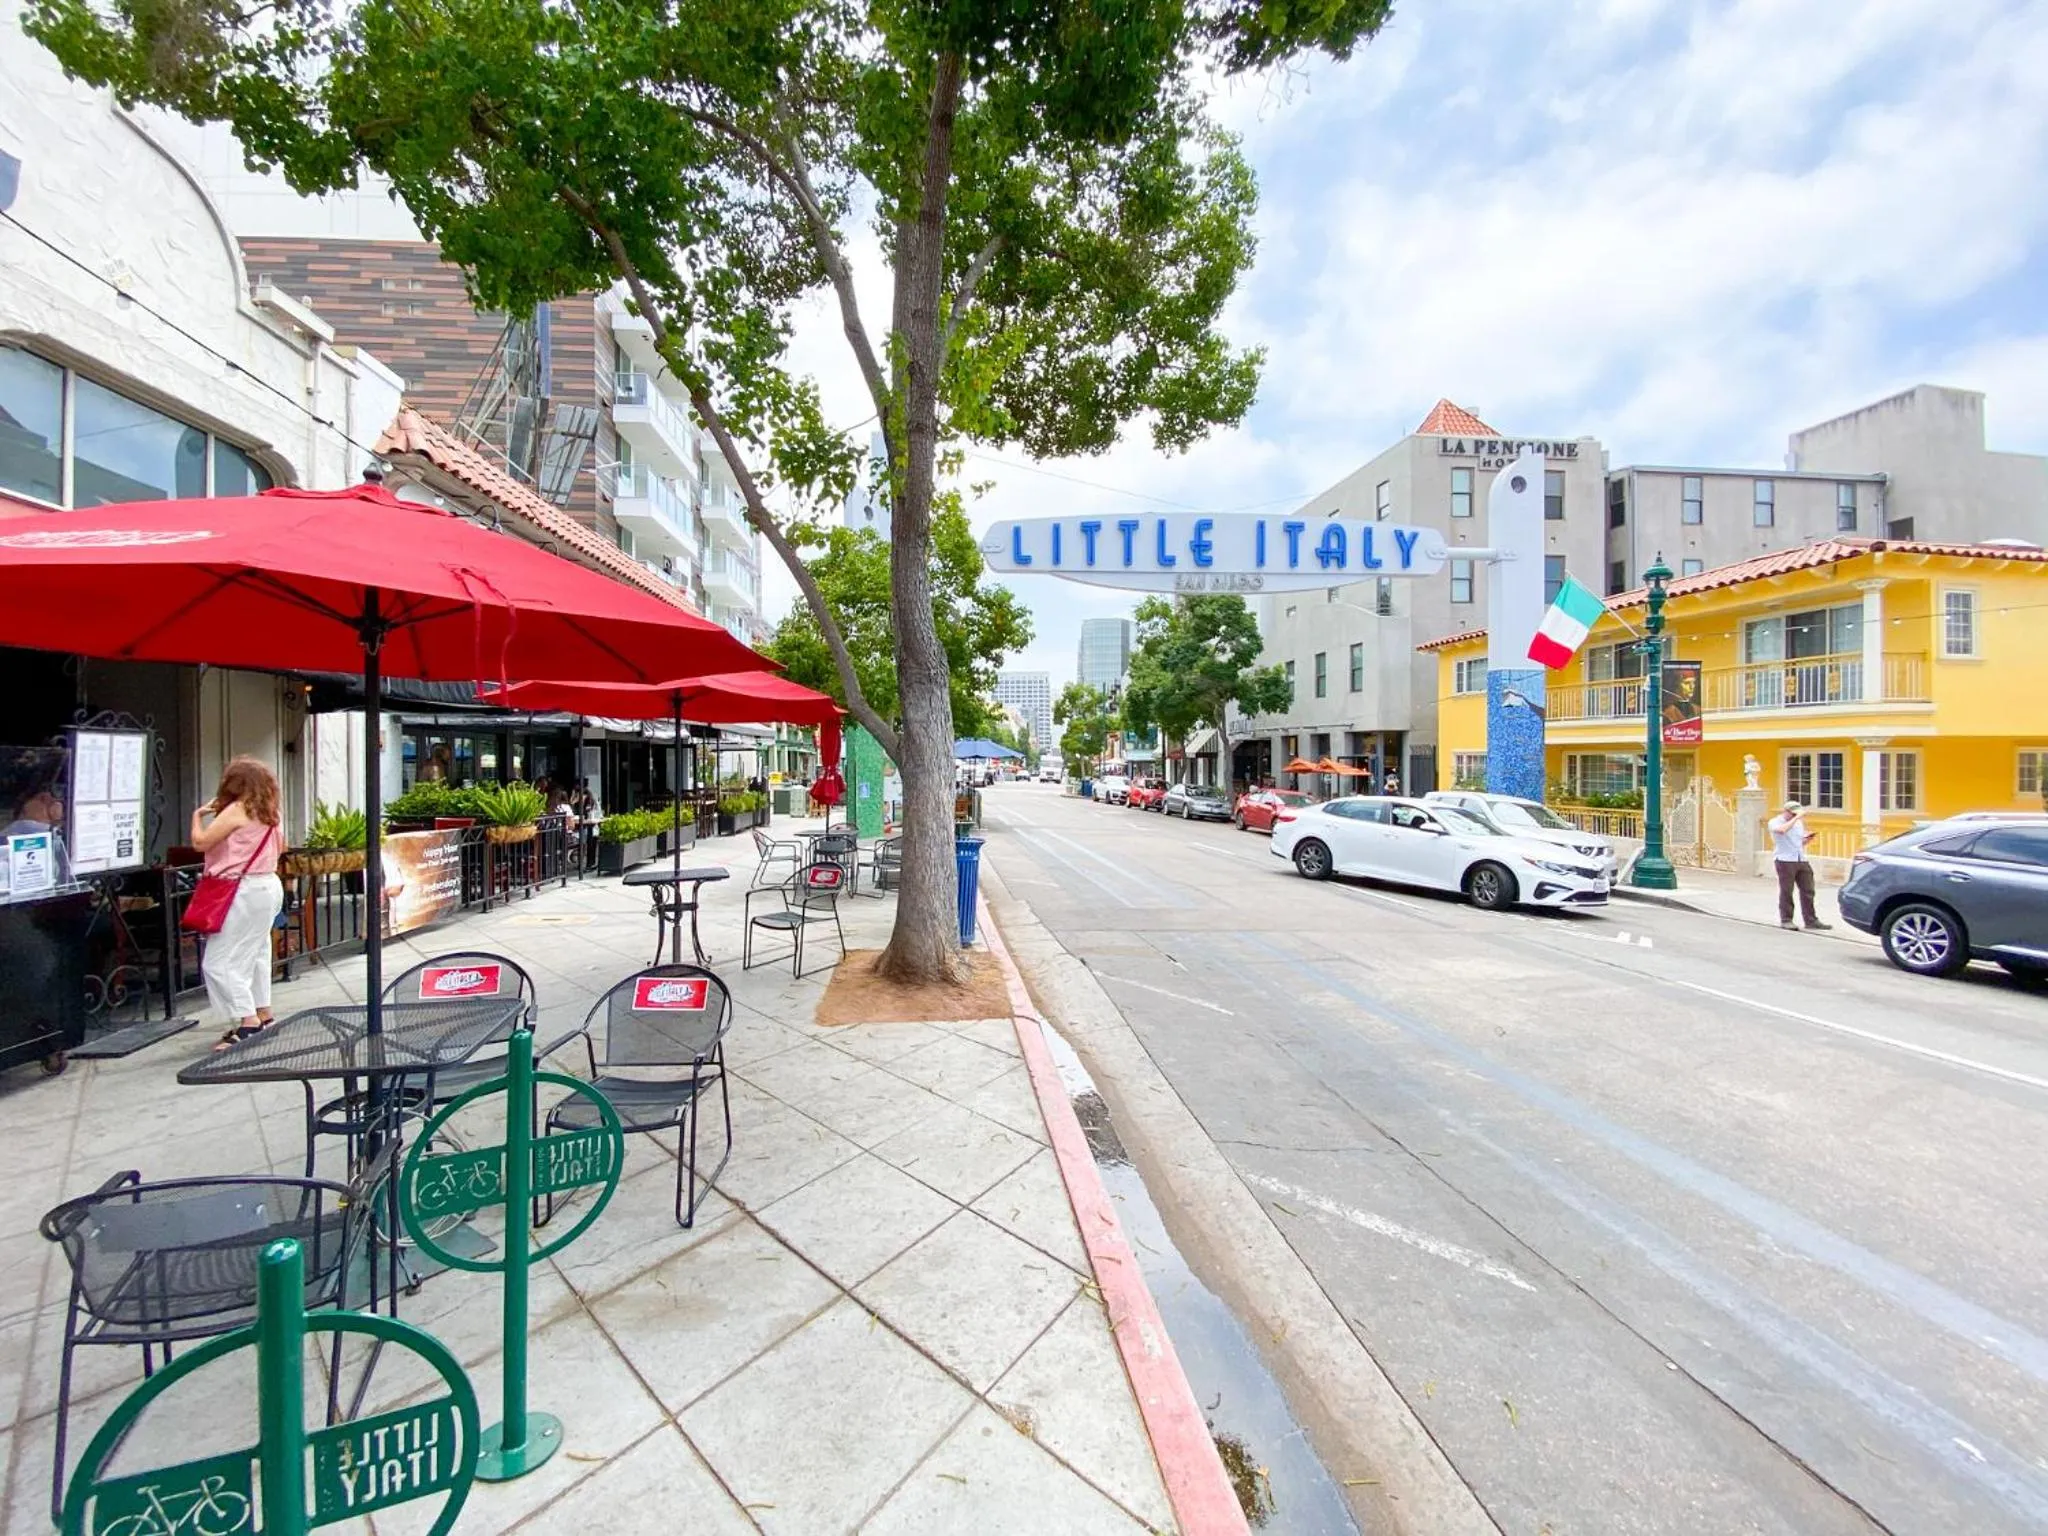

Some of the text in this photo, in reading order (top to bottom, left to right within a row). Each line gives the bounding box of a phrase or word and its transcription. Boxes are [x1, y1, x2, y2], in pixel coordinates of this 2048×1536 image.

[1441, 438, 1466, 454] LA
[1012, 518, 1420, 569] LITTLE ITALY
